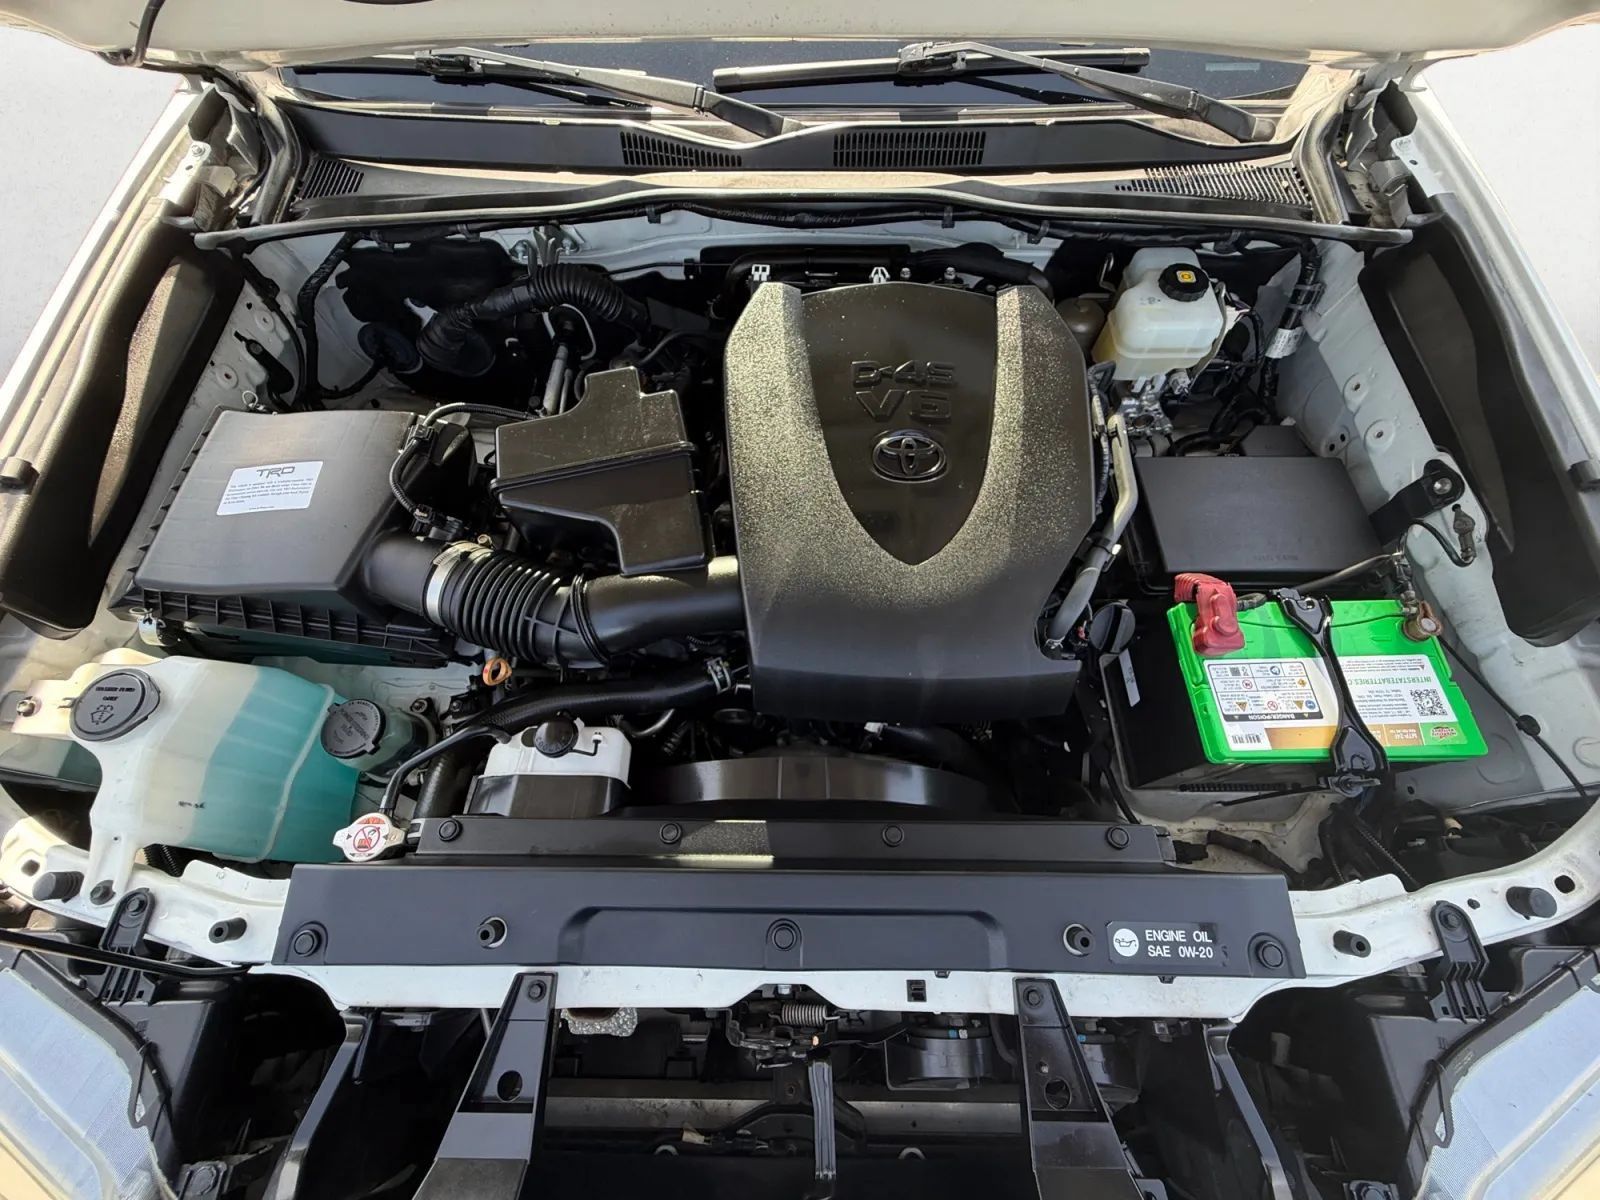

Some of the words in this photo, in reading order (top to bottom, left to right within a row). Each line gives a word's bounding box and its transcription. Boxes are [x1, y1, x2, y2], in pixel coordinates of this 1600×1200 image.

[850, 360, 957, 387] D-4S
[855, 389, 952, 422] V6
[257, 467, 295, 479] TRD
[1347, 676, 1432, 686] INTERSTATEBATTERIES.C
[1145, 929, 1186, 943] ENGINE
[1193, 930, 1213, 944] OIL
[1148, 945, 1171, 958] SAE
[1178, 946, 1213, 959] 0W-20
